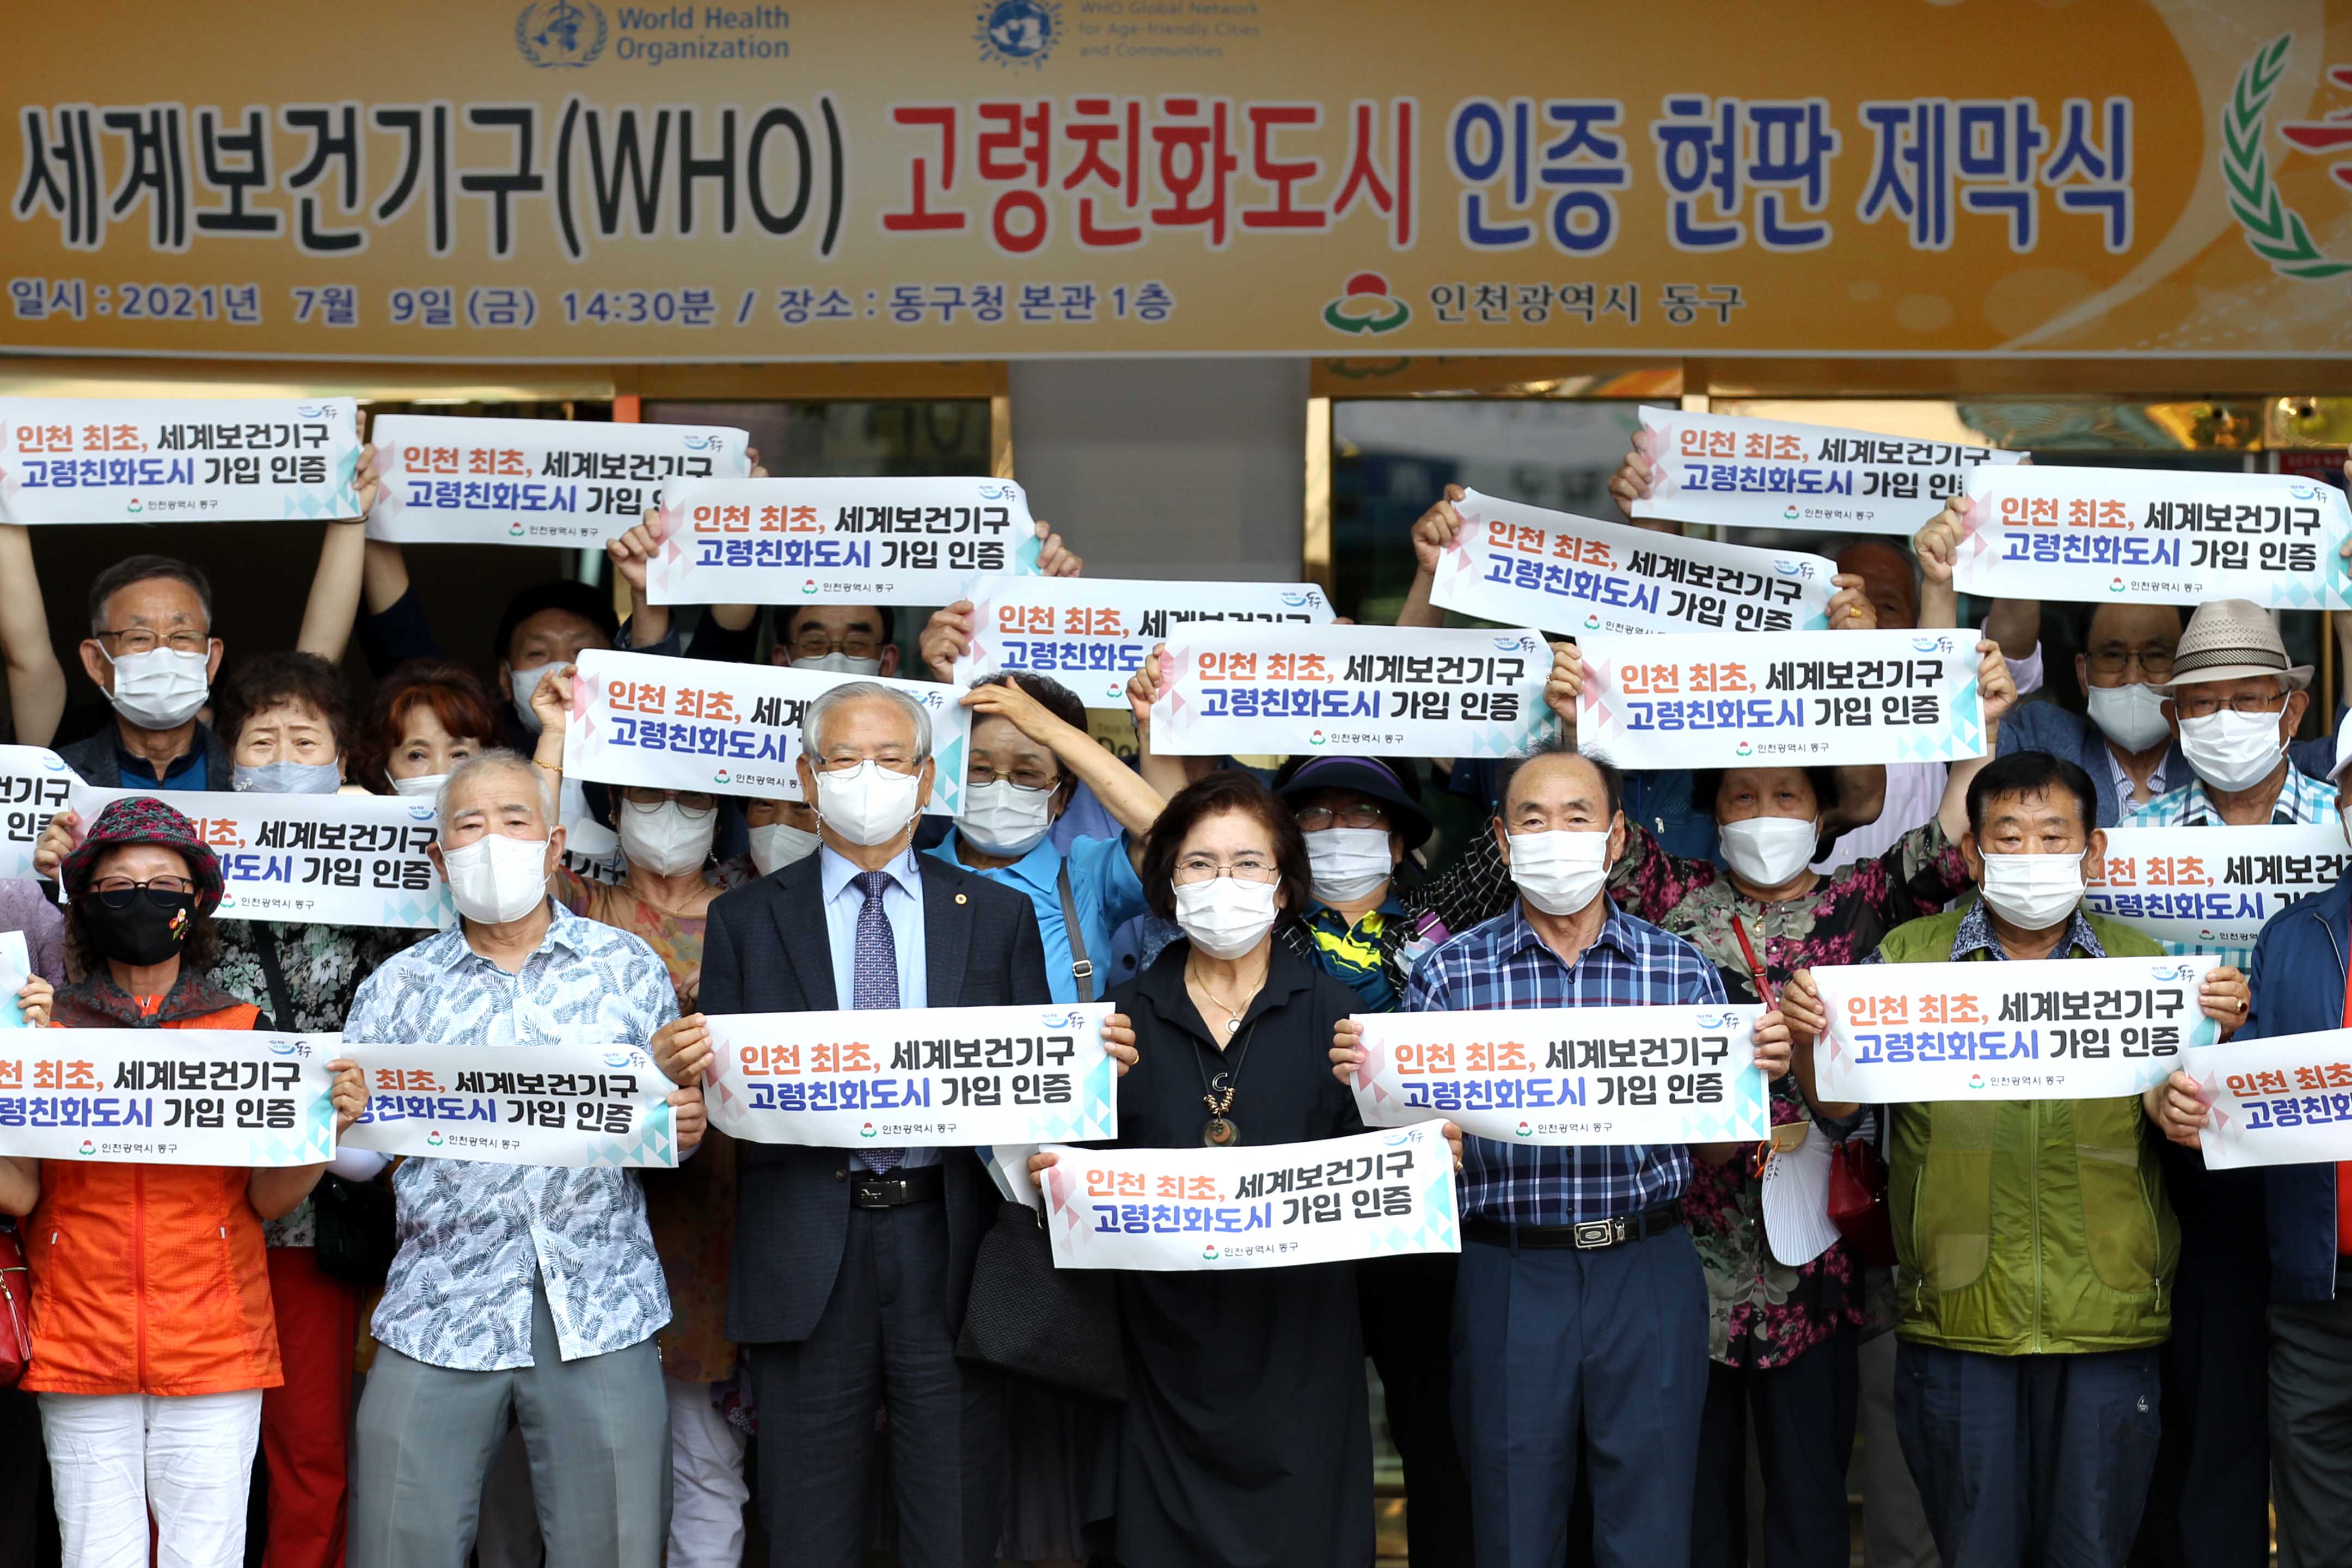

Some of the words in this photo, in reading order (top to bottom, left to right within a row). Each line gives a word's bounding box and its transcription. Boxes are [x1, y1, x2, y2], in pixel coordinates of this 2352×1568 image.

[618, 8, 694, 30] World
[706, 7, 789, 29] Health
[1080, 2, 1123, 14] WHO
[1129, 1, 1182, 14] Global
[1108, 23, 1208, 38] Age-friendly
[1216, 23, 1259, 35] Cities
[617, 36, 790, 65] Organization
[1080, 44, 1110, 57] and
[1116, 44, 1223, 57] Communities
[20, 97, 843, 258] 세계보건기구(WHO)
[884, 99, 1412, 253] 고령친화도시
[1454, 102, 1625, 250] 인증
[1658, 100, 1834, 246] 현판
[1865, 102, 2126, 247] 제막식
[295, 289, 356, 324] 7월
[391, 289, 452, 325] 9일
[468, 290, 536, 326] (금)
[564, 289, 715, 323] 14:30분
[891, 286, 1003, 321] 동구청
[1019, 286, 1095, 321] 본관
[1112, 286, 1172, 319] 1층
[1430, 284, 1637, 323] 인천광역시
[1662, 286, 1744, 323] 동구
[17, 425, 73, 453] 인천
[83, 424, 148, 453] 최초,
[157, 424, 329, 450] 세계보건기구
[1681, 430, 1735, 458] 인천
[1744, 433, 1809, 463] 최초,
[1818, 438, 1990, 467] 세계보건기구
[21, 457, 193, 487] 고령친화도시
[205, 457, 260, 485] 가입
[271, 456, 326, 483] 인증
[403, 447, 459, 474] 인천
[469, 448, 532, 478] 최초,
[1681, 464, 1852, 495] 고령친화도시
[1863, 472, 1918, 499] 가입
[148, 500, 195, 510] 인천광역시
[200, 500, 218, 509] 동구
[406, 481, 576, 512] 고령친화도시
[586, 487, 641, 515] 가입
[694, 505, 750, 532] 인천
[759, 505, 825, 534] 최초,
[835, 506, 1010, 534] 세계보건기구
[1805, 509, 1852, 519] 인천광역시
[1856, 511, 1874, 520] 동구
[2001, 498, 2058, 527] 인천
[2068, 499, 2134, 531] 최초,
[2144, 502, 2320, 536] 세계보건기구
[530, 526, 576, 536] 인천광역시
[580, 528, 598, 537] 동구
[696, 540, 870, 568] 고령친화도시
[881, 541, 937, 569] 가입
[948, 542, 1004, 569] 인증
[1489, 520, 1545, 554] 인천
[1551, 534, 1617, 575] 최초,
[1626, 550, 1802, 605] 세계보건기구
[2002, 533, 2180, 567] 고령친화도시
[2190, 540, 2248, 569] 가입
[2259, 542, 2316, 572] 인증
[823, 583, 871, 592] 인천광역시
[875, 584, 893, 592] 동구
[1485, 553, 1661, 614] 고령친화도시
[1667, 590, 1726, 627] 가입
[2132, 581, 2179, 592] 인천광역시
[2184, 584, 2202, 593] 동구
[999, 605, 1054, 634] 인천
[1064, 607, 1129, 639] 최초,
[1001, 641, 1147, 671] 고령친화도
[1198, 652, 1257, 680] 인천
[1267, 653, 1333, 683] 최초,
[1344, 654, 1524, 686] 세계보건기구
[1621, 664, 1679, 694] 인천
[1689, 662, 1756, 694] 최초,
[1766, 660, 1943, 690] 세계보건기구
[609, 681, 665, 714] 인천
[675, 688, 741, 725] 최초,
[1200, 688, 1380, 718] 고령친화도시
[1391, 691, 1449, 720] 가입
[1461, 693, 1518, 721] 인증
[1627, 698, 1803, 730] 고령친화도시
[1815, 697, 1871, 726] 가입
[1882, 695, 1939, 725] 인증
[610, 716, 787, 762] 고령친화도시
[1331, 733, 1380, 743] 인천광역시
[1385, 734, 1403, 744] 동구
[1758, 744, 1805, 754] 인천광역시
[1811, 743, 1829, 752] 동구
[736, 774, 785, 787] 인천광역시
[256, 822, 437, 854] 세계보건기구
[302, 857, 362, 886] 가입
[373, 860, 431, 890] 인증
[2146, 856, 2214, 887] 최초,
[2224, 854, 2352, 885] 세계보건
[241, 897, 290, 908] 인천광역시
[296, 900, 314, 910] 동구
[2086, 892, 2264, 919] 고령친화도시
[1848, 995, 1908, 1026] 인천
[1919, 993, 1988, 1025] 최초,
[1998, 989, 2184, 1022] 세계보건기구
[740, 1045, 800, 1075] 인천
[811, 1042, 880, 1074] 최초,
[890, 1037, 1075, 1070] 세계보건기구
[1395, 1043, 1455, 1075] 인천
[1466, 1041, 1535, 1073] 최초,
[1546, 1037, 1728, 1069] 세계보건기구
[1854, 1030, 2038, 1064] 고령친화도시
[2050, 1028, 2109, 1058] 가입
[2121, 1026, 2179, 1057] 인증
[33, 1060, 103, 1092] 최초,
[113, 1061, 301, 1091] 세계보건기구
[376, 1069, 445, 1093] 최초,
[455, 1071, 639, 1098] 세계보건기구
[1401, 1078, 1585, 1110] 고령친화도시
[1597, 1075, 1656, 1105] 가입
[1668, 1073, 1723, 1104] 인증
[1991, 1076, 2041, 1086] 인천광역시
[2046, 1076, 2065, 1086] 동구
[2226, 1070, 2290, 1097] 인천
[747, 1077, 930, 1111] 고령친화도시
[941, 1075, 1001, 1106] 가입
[1012, 1074, 1071, 1104] 인증
[0, 1097, 152, 1127] 령친화도시
[164, 1098, 224, 1128] 가입
[236, 1099, 295, 1128] 인증
[507, 1100, 565, 1128] 가입
[577, 1102, 633, 1134] 인증
[449, 1135, 497, 1148] 인천광역시
[502, 1140, 519, 1150] 동구
[883, 1124, 932, 1135] 인천광역시
[938, 1124, 956, 1134] 동구
[1538, 1124, 1588, 1134] 인천광역시
[1594, 1123, 1612, 1132] 동구
[102, 1143, 152, 1153] 인천광역시
[158, 1144, 177, 1154] 동구
[1087, 1169, 1145, 1197] 인천
[1156, 1175, 1225, 1202] 최초,
[1235, 1151, 1414, 1200] 세계보건기구
[1092, 1202, 1271, 1234] 고령친화도시
[1283, 1193, 1341, 1224] 가입
[1352, 1186, 1412, 1218] 인증
[1224, 1245, 1274, 1257] 인천광역시
[1279, 1242, 1298, 1253] 동구
